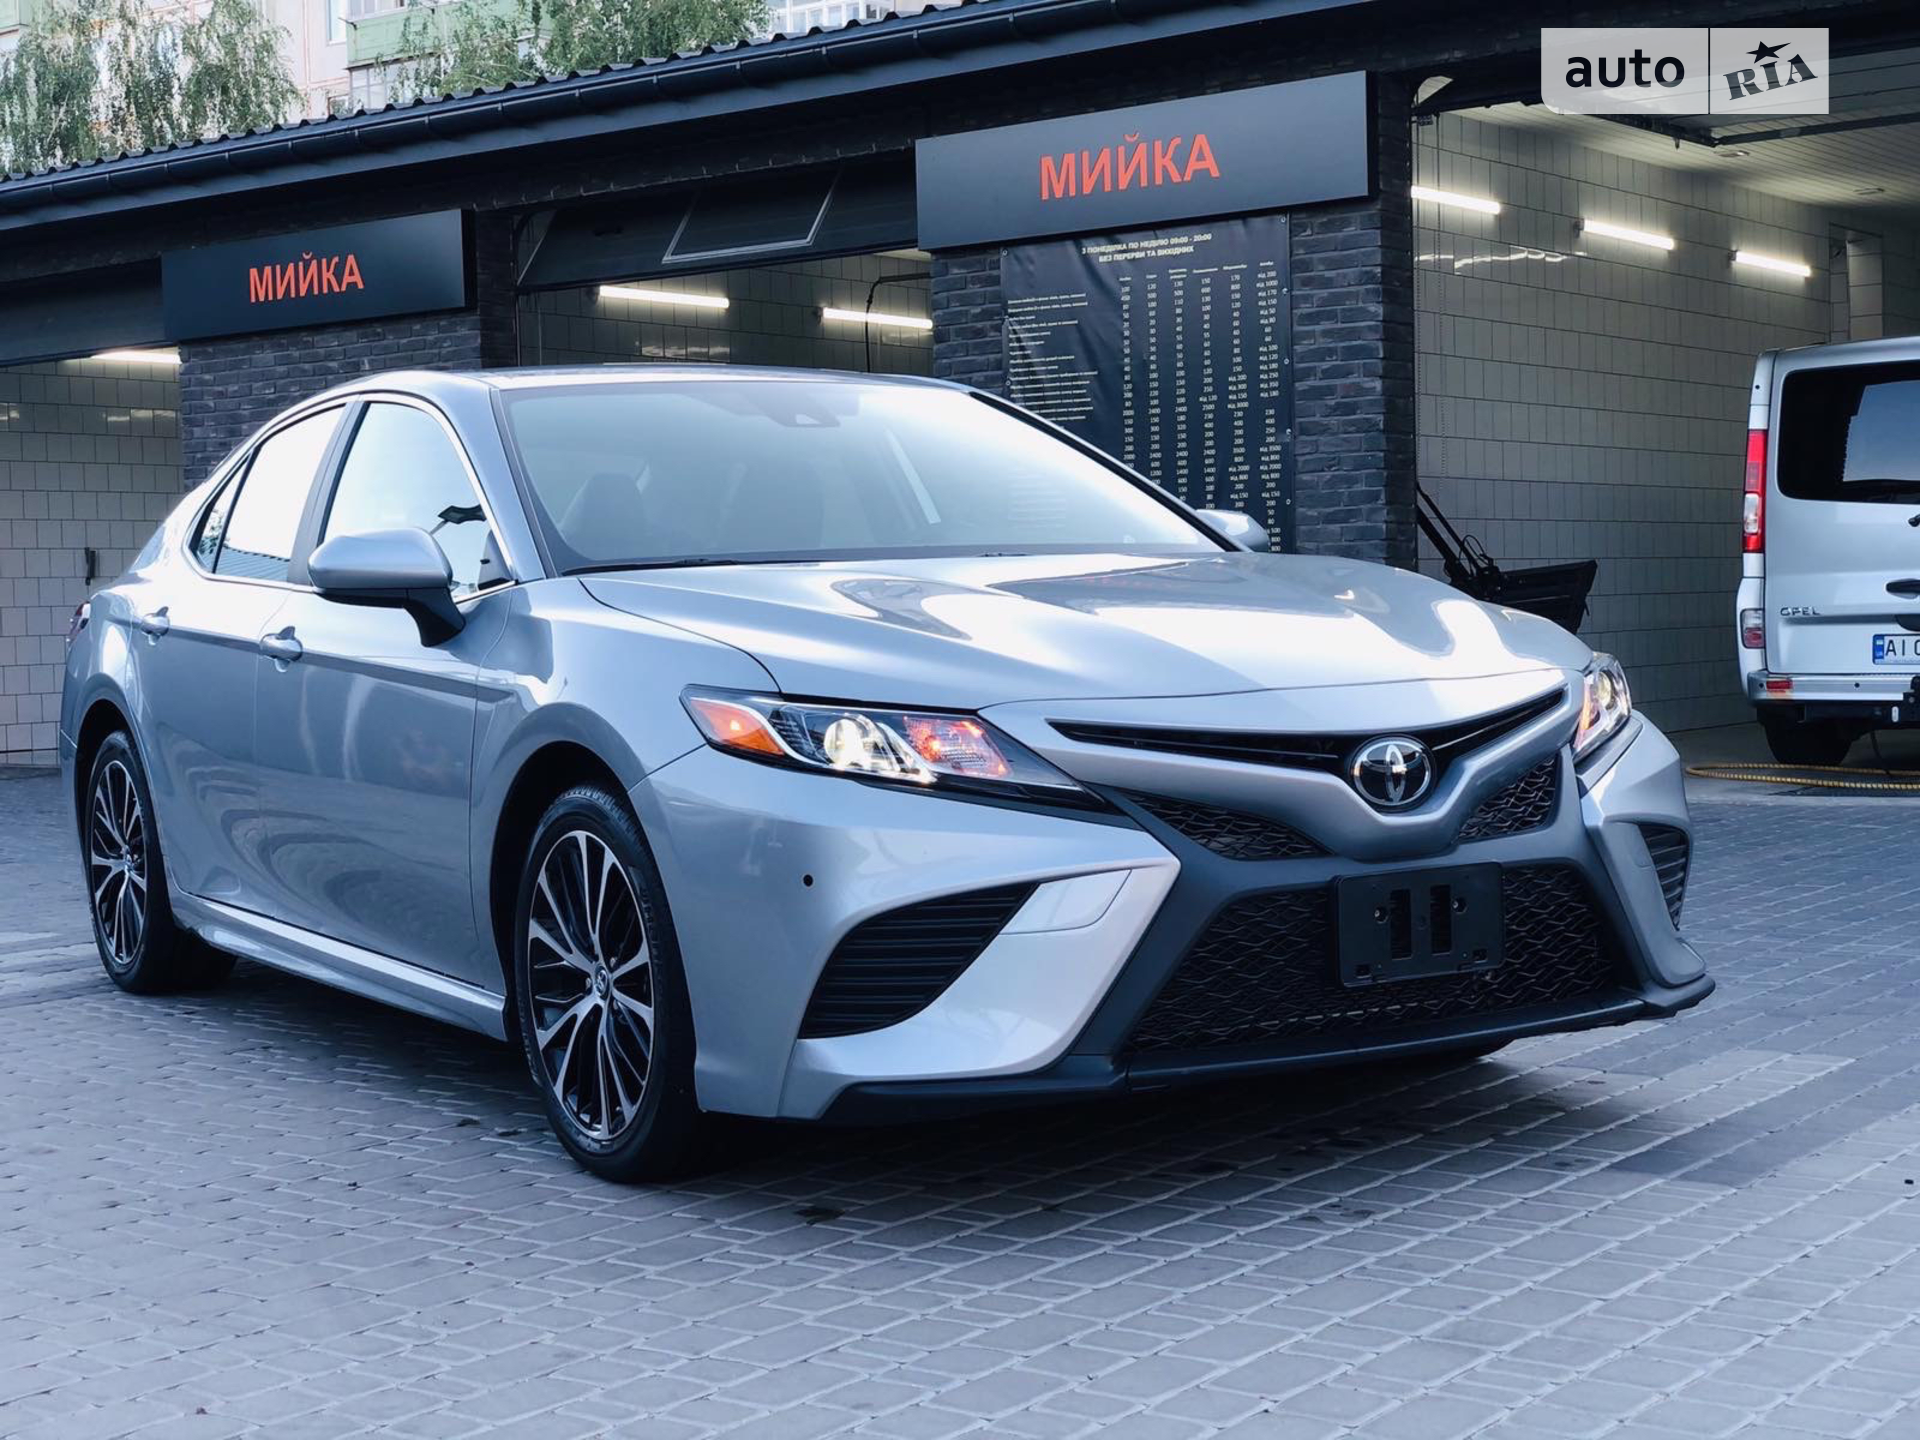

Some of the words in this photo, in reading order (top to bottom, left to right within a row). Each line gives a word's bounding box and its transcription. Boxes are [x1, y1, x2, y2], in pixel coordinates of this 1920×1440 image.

[1040, 132, 1220, 201] МИЙКА
[249, 251, 364, 303] МИЙКА
[1146, 249, 1157, 257] ТА
